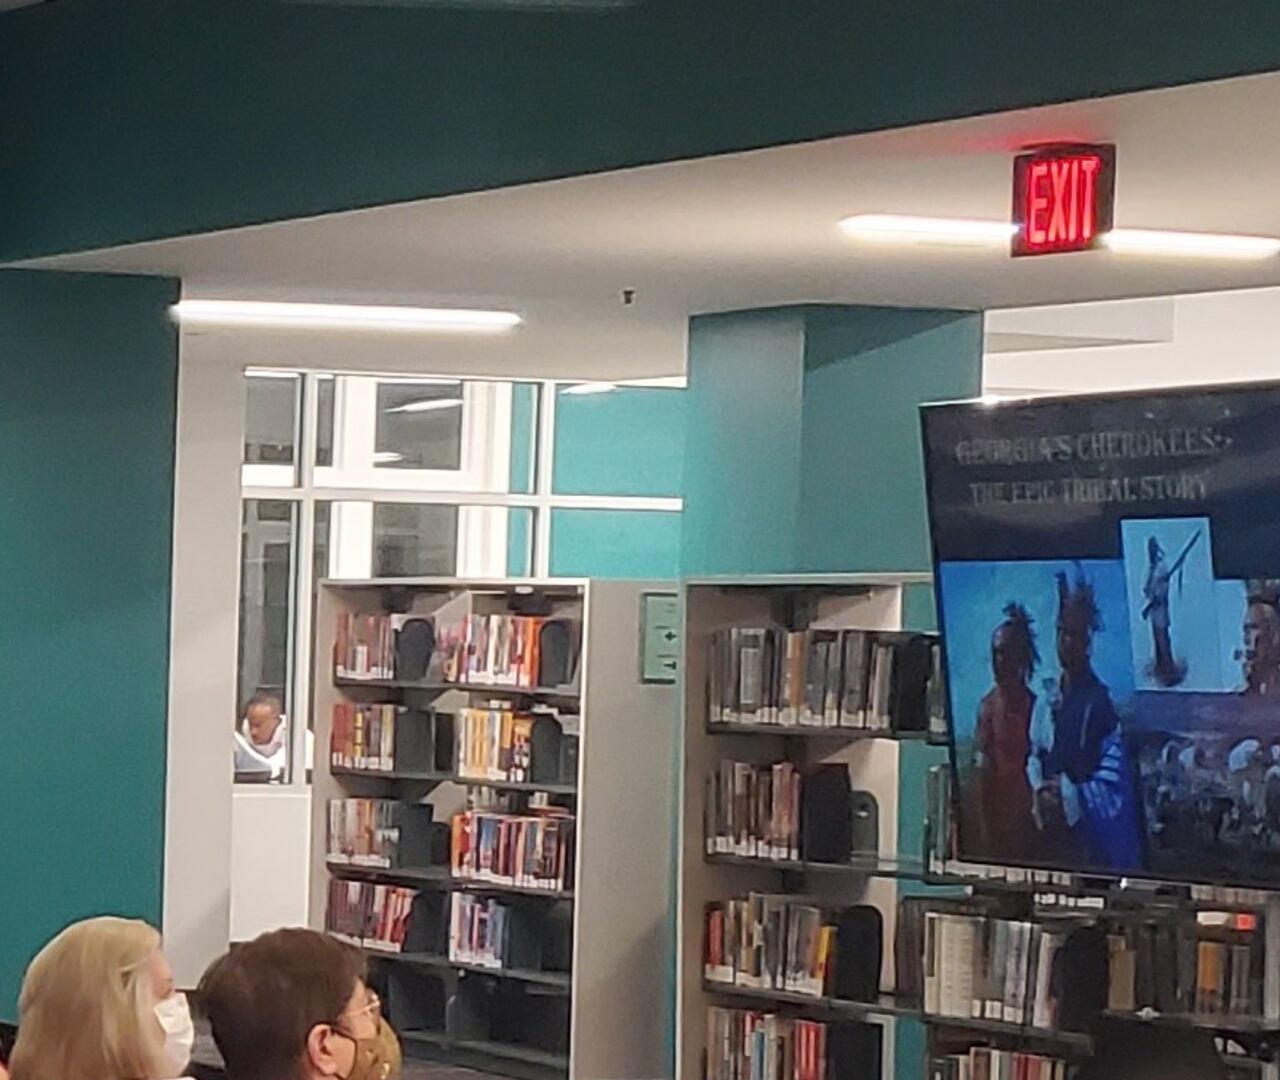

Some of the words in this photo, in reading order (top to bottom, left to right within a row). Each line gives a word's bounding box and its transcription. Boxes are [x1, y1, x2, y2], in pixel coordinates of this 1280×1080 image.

[1029, 158, 1098, 244] EXIT
[969, 481, 1008, 507] THE
[1010, 479, 1055, 505] EPIC
[1061, 475, 1137, 504] TRIBAL
[1139, 471, 1209, 501] STORY
